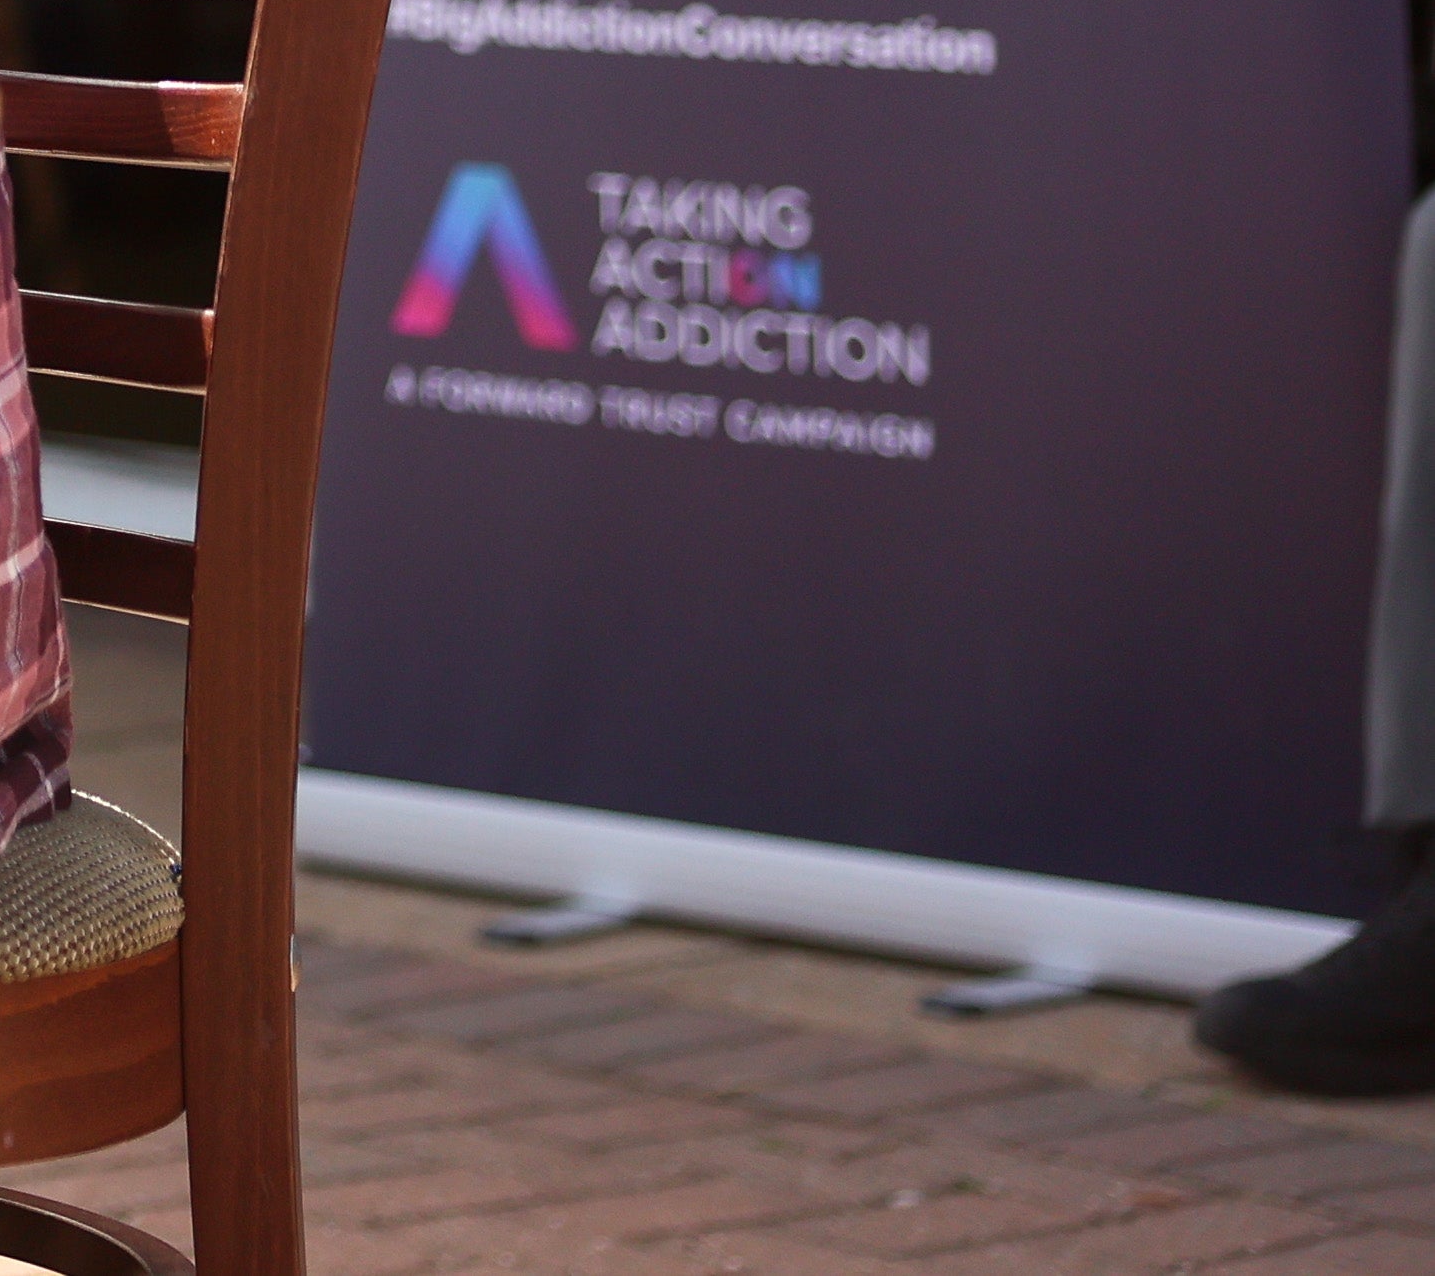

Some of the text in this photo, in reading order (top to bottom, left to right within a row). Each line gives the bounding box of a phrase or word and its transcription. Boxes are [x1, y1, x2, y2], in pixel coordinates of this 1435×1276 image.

[590, 174, 809, 246] TAKING
[591, 239, 820, 308] ACTION
[593, 303, 930, 383] ADDICTION
